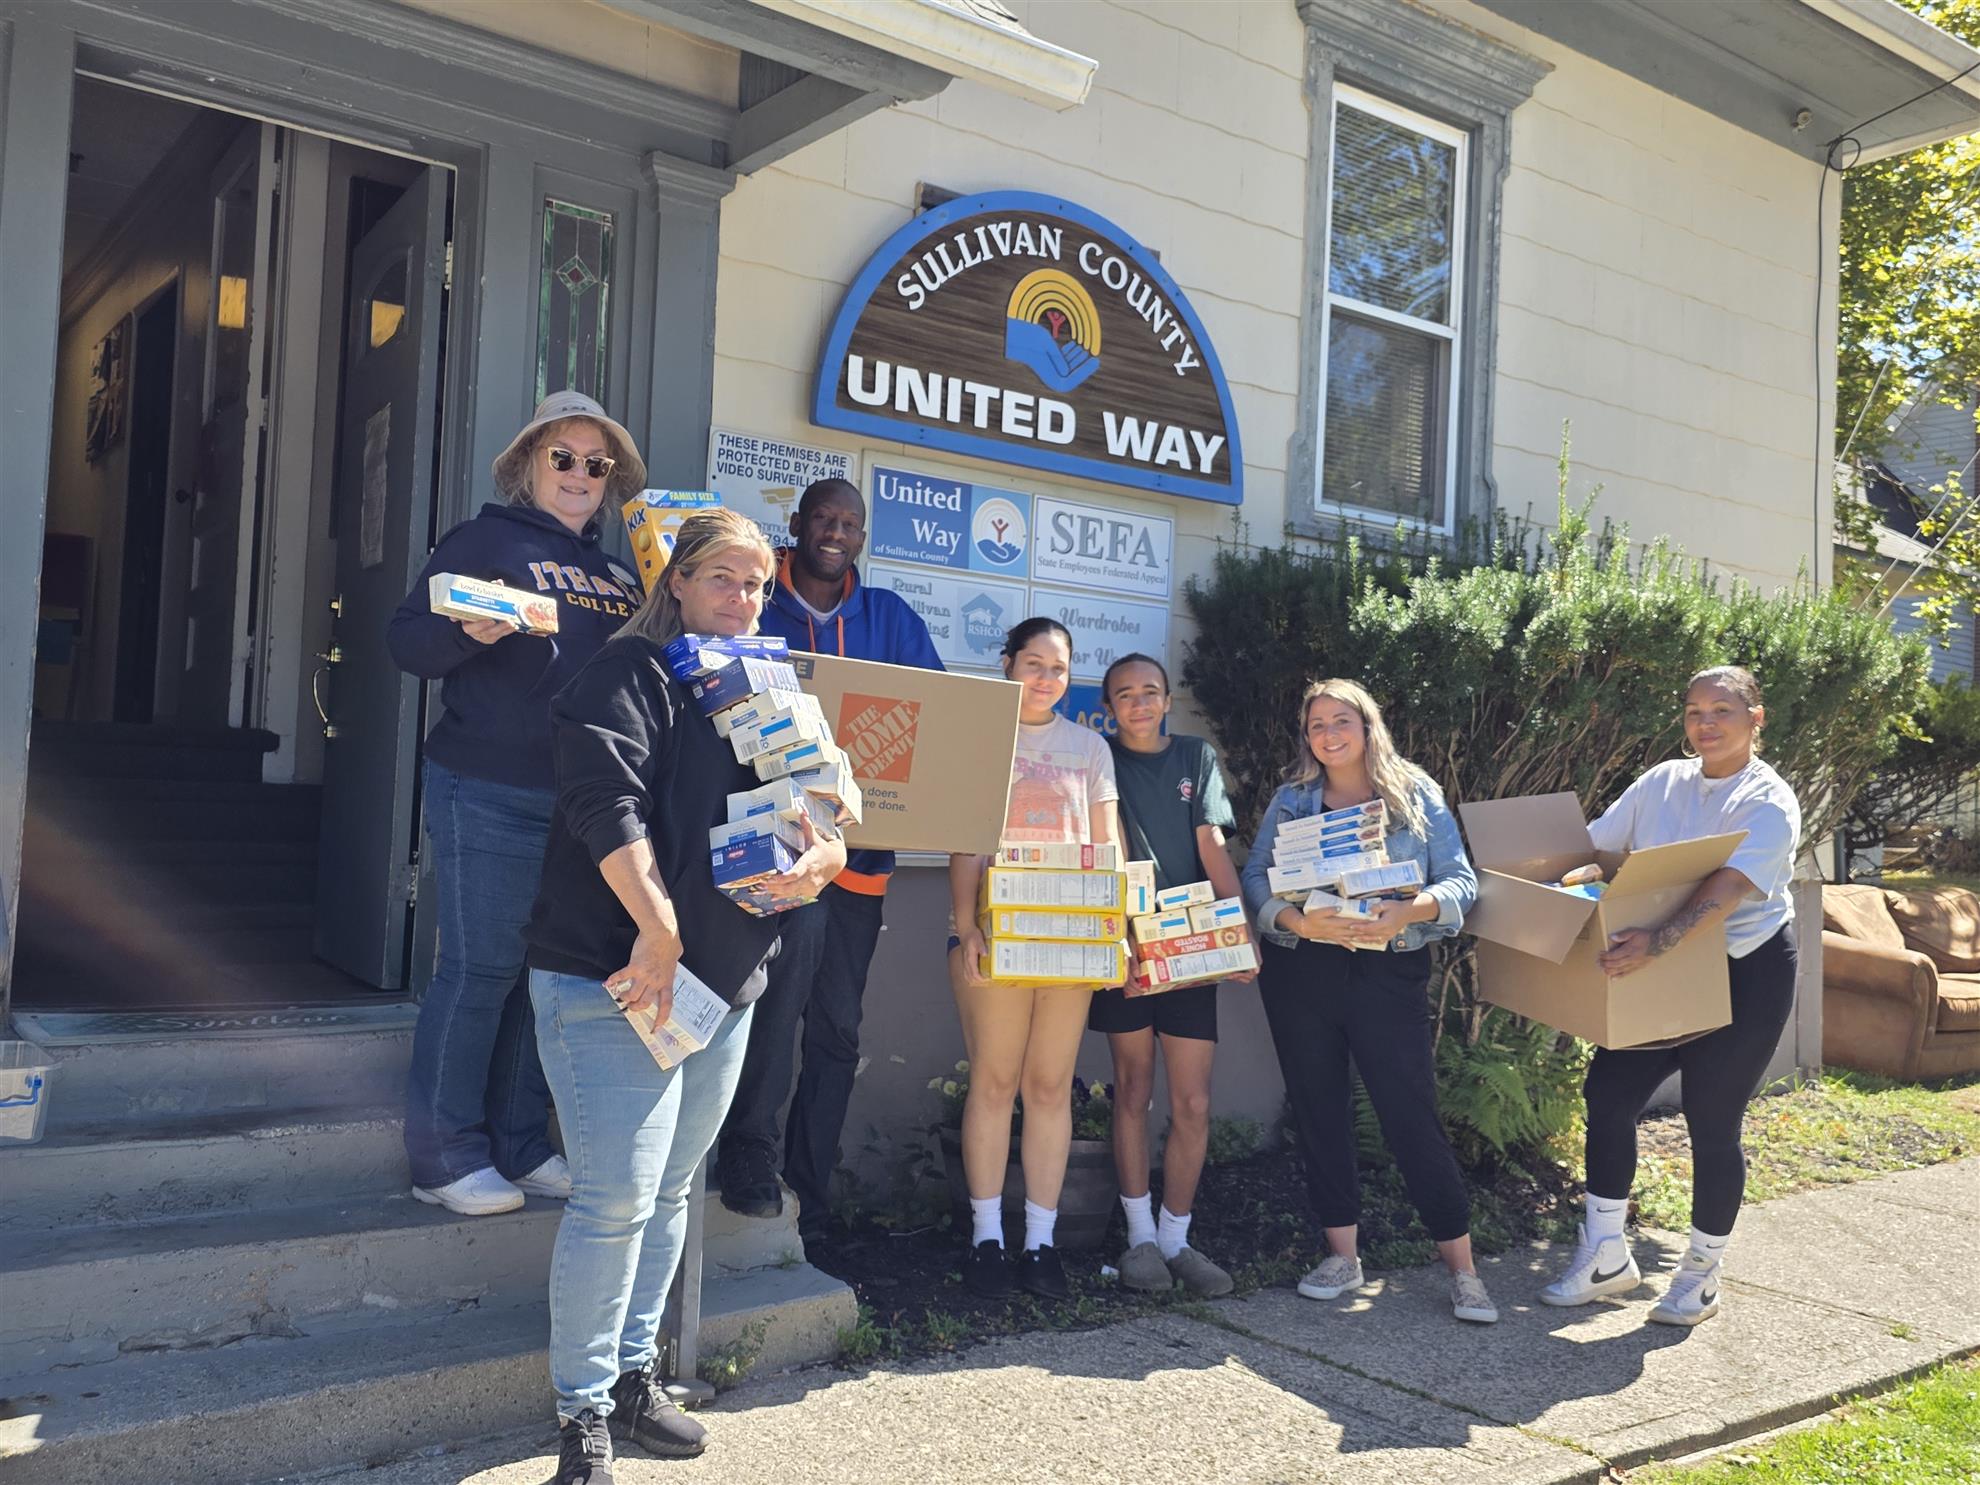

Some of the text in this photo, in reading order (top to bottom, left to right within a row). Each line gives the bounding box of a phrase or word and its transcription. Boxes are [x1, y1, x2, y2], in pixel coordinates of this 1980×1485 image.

[897, 222, 1201, 376] SULLIVAN COUNTY
[847, 354, 1226, 474] UNITED WAY
[717, 448, 791, 471] PROTECTED
[794, 463, 810, 475] BY
[812, 465, 826, 477] 24
[719, 433, 848, 468] THESE PREMISES ARE
[716, 461, 815, 489] VIDEO SURVEILL
[669, 491, 715, 502] FAMILY SIZE
[878, 474, 962, 512] United
[627, 508, 646, 533] KIX
[911, 518, 962, 556] Way
[1050, 510, 1160, 569] SEFA
[875, 543, 949, 565] of Sullivan County
[1037, 555, 1167, 585] State Employees Federated Appeal
[892, 576, 933, 596] Rural
[565, 592, 630, 617] COLLE
[910, 599, 951, 618] llivan
[967, 623, 1003, 638] RSHCO
[1059, 606, 1141, 635] Wardrobes
[1072, 651, 1091, 665] or
[846, 704, 881, 737] THE
[863, 731, 915, 779] DEPOT
[867, 787, 899, 799] doers
[879, 800, 909, 812] done.
[1174, 934, 1210, 947] ROASTED
[1181, 943, 1207, 954] HONEY
